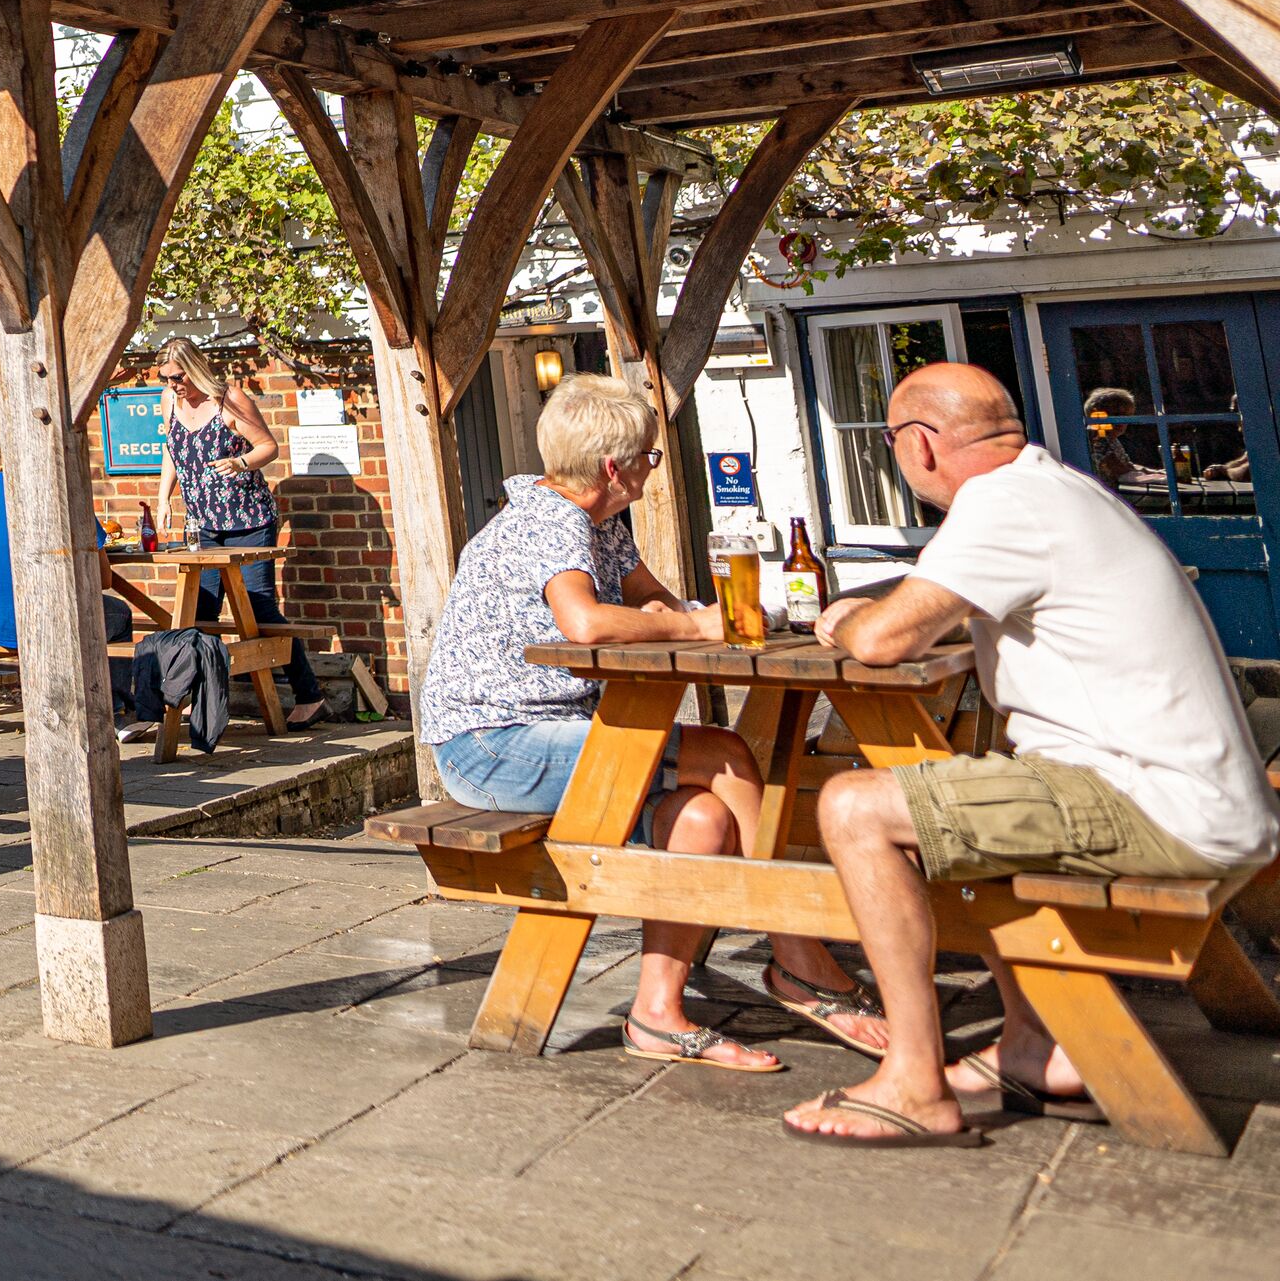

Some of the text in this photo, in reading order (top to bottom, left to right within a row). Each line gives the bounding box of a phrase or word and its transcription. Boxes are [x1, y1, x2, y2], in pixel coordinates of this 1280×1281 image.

[126, 404, 148, 416] TO
[120, 443, 166, 455] RECE
[726, 476, 738, 484] No
[716, 485, 750, 494] Smoking
